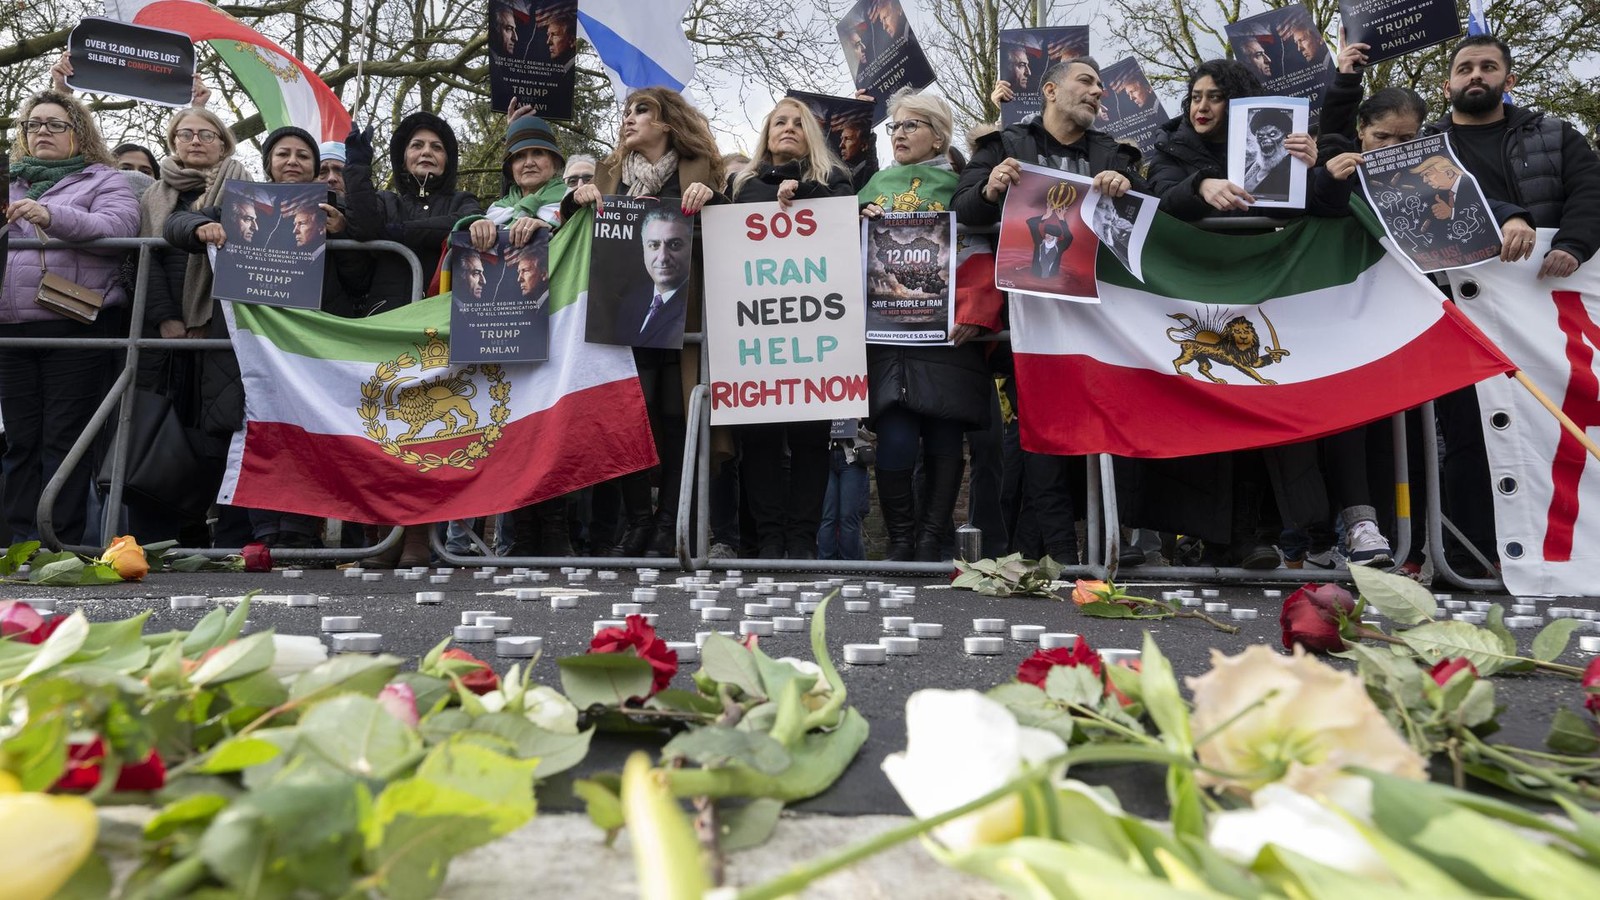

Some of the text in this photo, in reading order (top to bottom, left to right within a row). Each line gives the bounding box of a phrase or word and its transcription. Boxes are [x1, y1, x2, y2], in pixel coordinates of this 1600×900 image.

[1371, 17, 1384, 25] SAVE
[1386, 9, 1406, 20] PEOPLE
[1376, 12, 1422, 35] TRUMP
[1381, 30, 1426, 51] PAHLAVI
[85, 39, 180, 63] OVER 12,000 LIVES LOST
[88, 53, 117, 64] SILENCE
[127, 61, 172, 74] COMPLICITY
[878, 68, 905, 93] TRUMP
[512, 86, 548, 96] TRUMP
[1423, 138, 1440, 147] LOCKED
[1368, 167, 1386, 175] WHERE
[1408, 157, 1422, 166] NOW?
[1377, 156, 1396, 166] LOADED
[1408, 149, 1423, 158] READY
[618, 201, 645, 209] Pahlavi
[626, 213, 639, 221] OF
[746, 209, 817, 241] SOS
[595, 222, 633, 240] IRAN
[887, 249, 930, 266] 12,000
[248, 272, 292, 284] TRUMP
[744, 256, 826, 286] IRAN
[246, 288, 290, 299] PAHLAVI
[737, 292, 846, 326] NEEDS
[480, 330, 520, 339] TRUMP
[738, 335, 839, 366] HELP
[712, 374, 868, 410] RIGHT NOW
